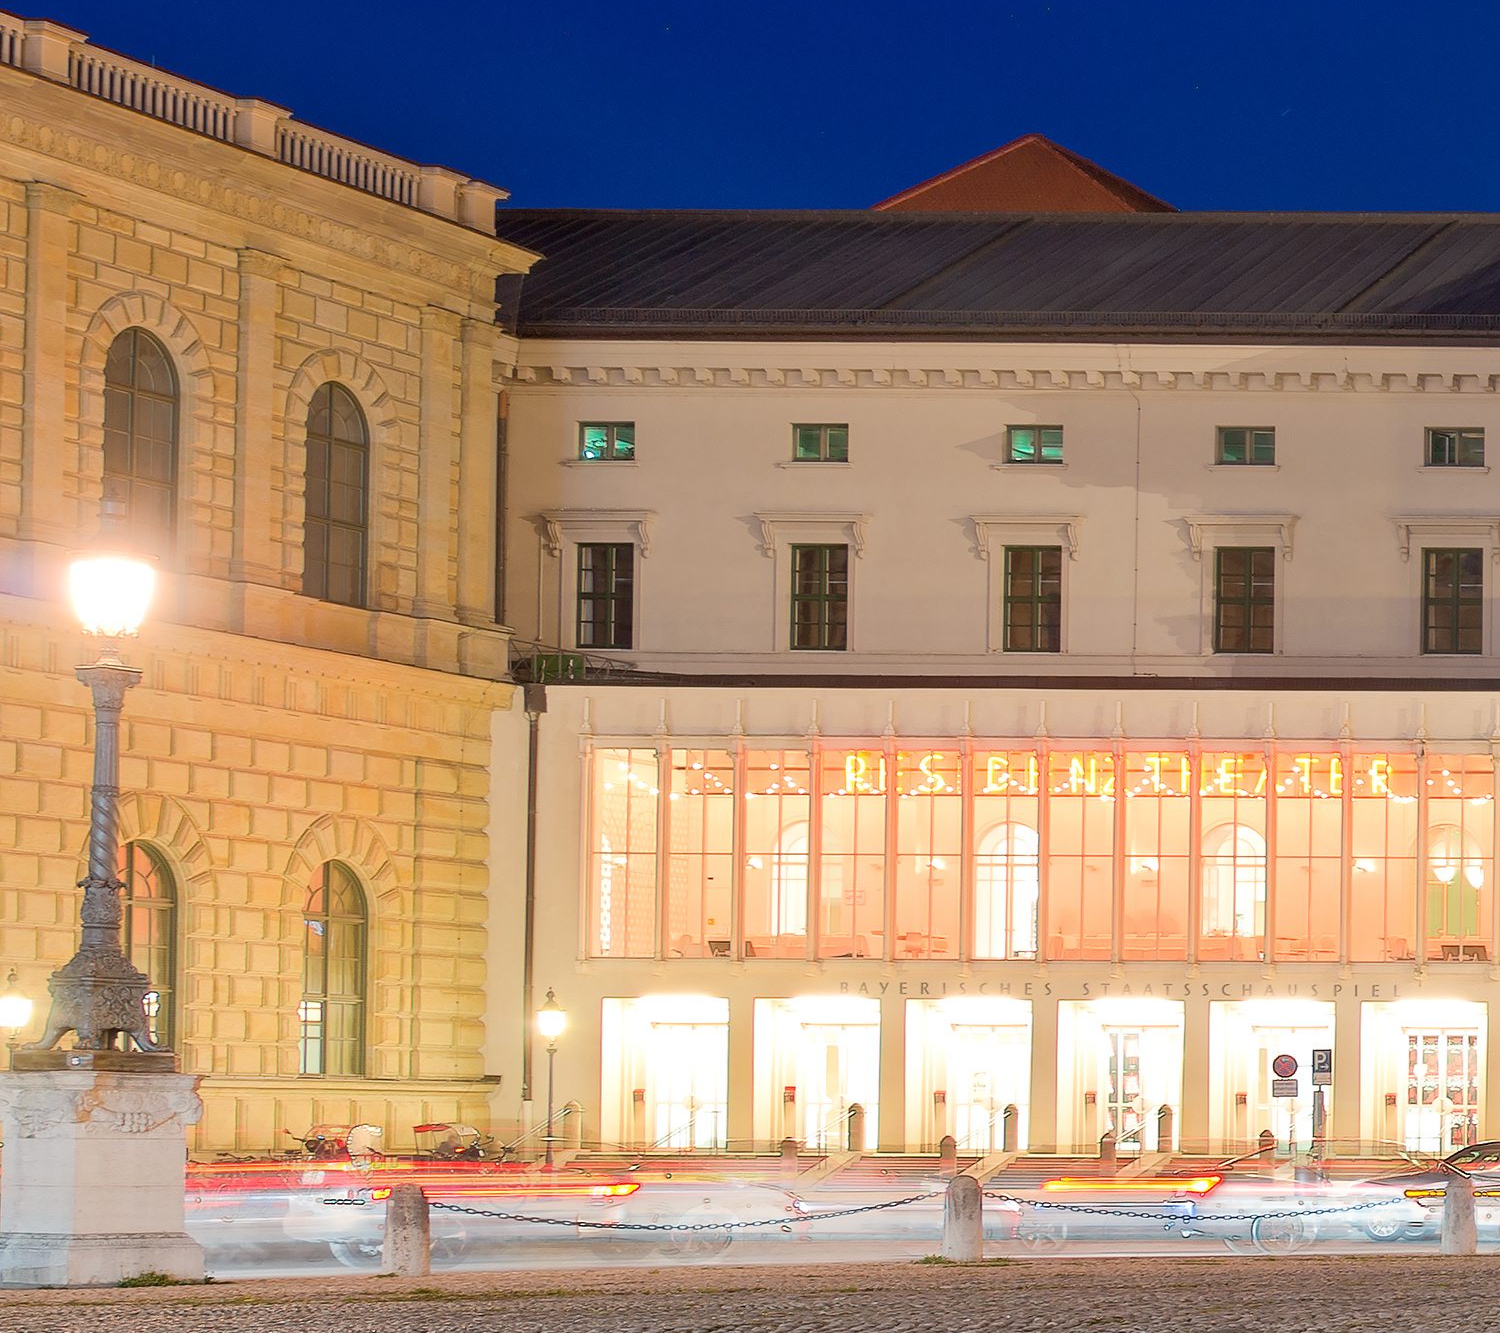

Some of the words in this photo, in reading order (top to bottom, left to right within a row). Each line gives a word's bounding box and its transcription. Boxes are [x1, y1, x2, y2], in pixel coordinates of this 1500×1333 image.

[845, 754, 1392, 794] RESDENZTHEATER
[840, 982, 1052, 996] BAYERISCHES
[1082, 983, 1402, 997] STAATSSCHAUSPIEL
[1314, 1051, 1327, 1071] P
